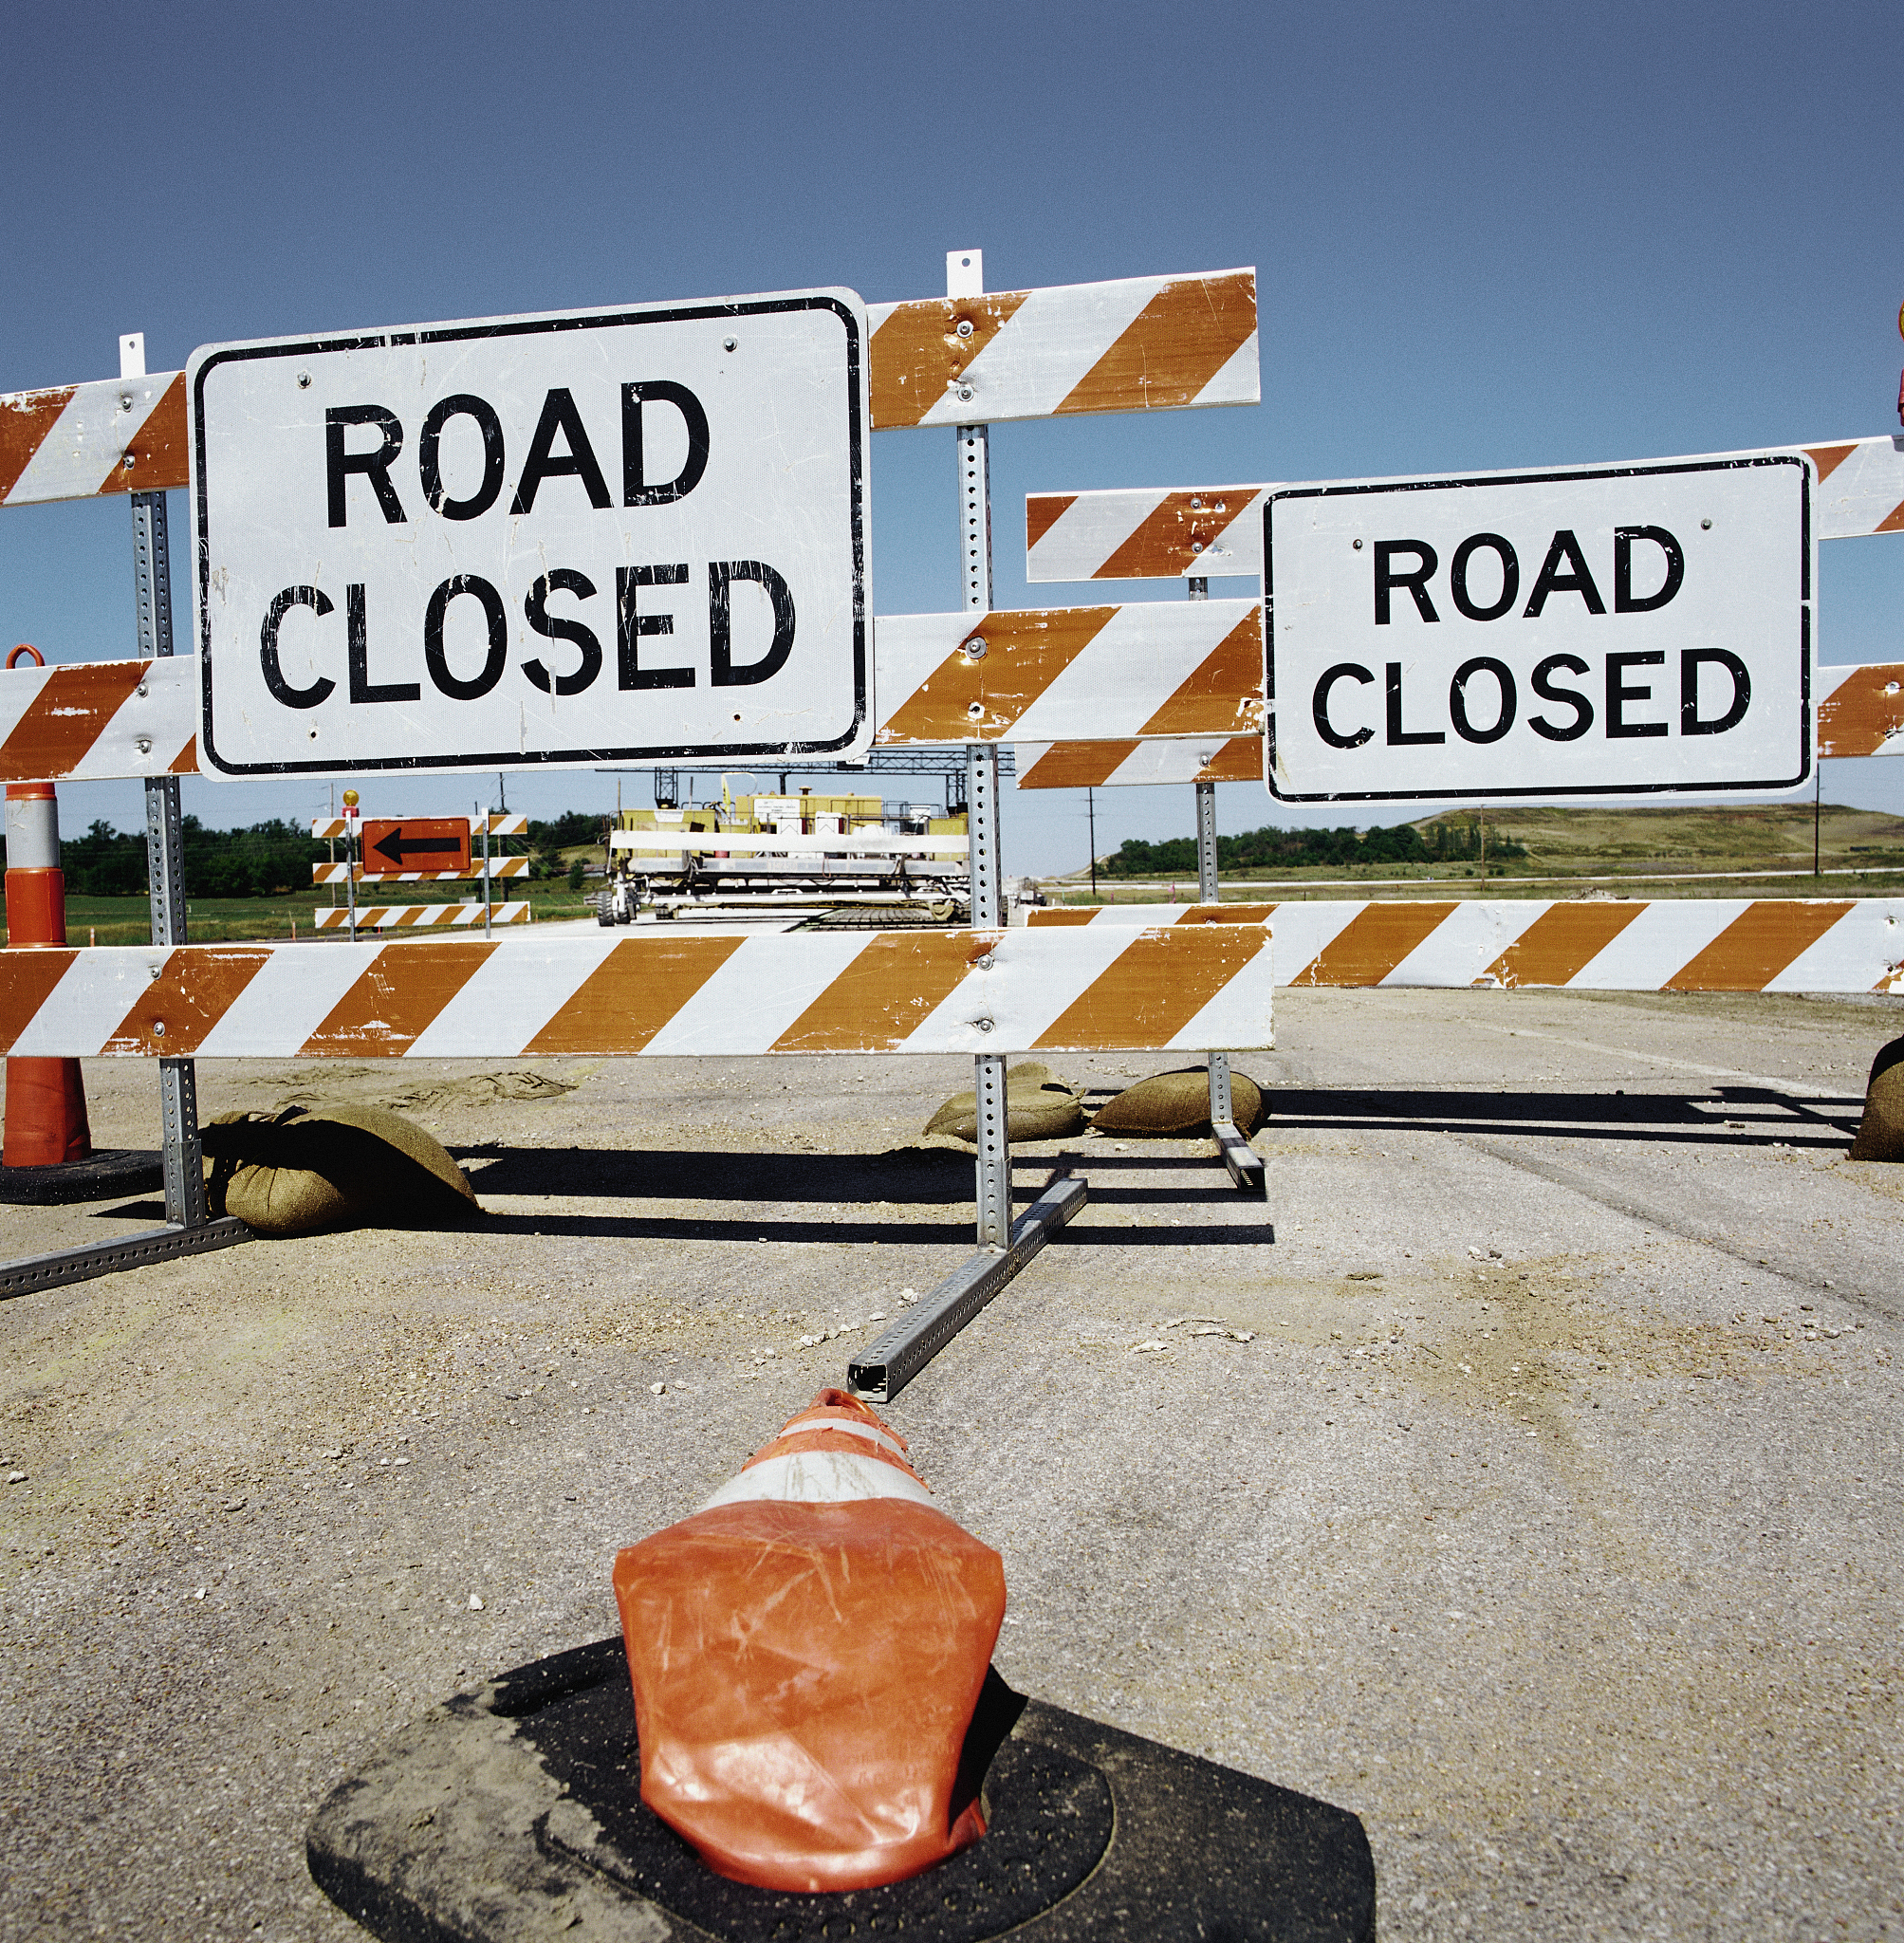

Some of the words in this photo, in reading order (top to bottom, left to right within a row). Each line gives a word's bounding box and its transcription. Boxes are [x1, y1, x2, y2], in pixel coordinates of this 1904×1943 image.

[326, 380, 711, 528] ROAD
[261, 561, 796, 710] CLOSED
[1375, 526, 1685, 625] ROAD
[1313, 648, 1751, 749] CLOSED
